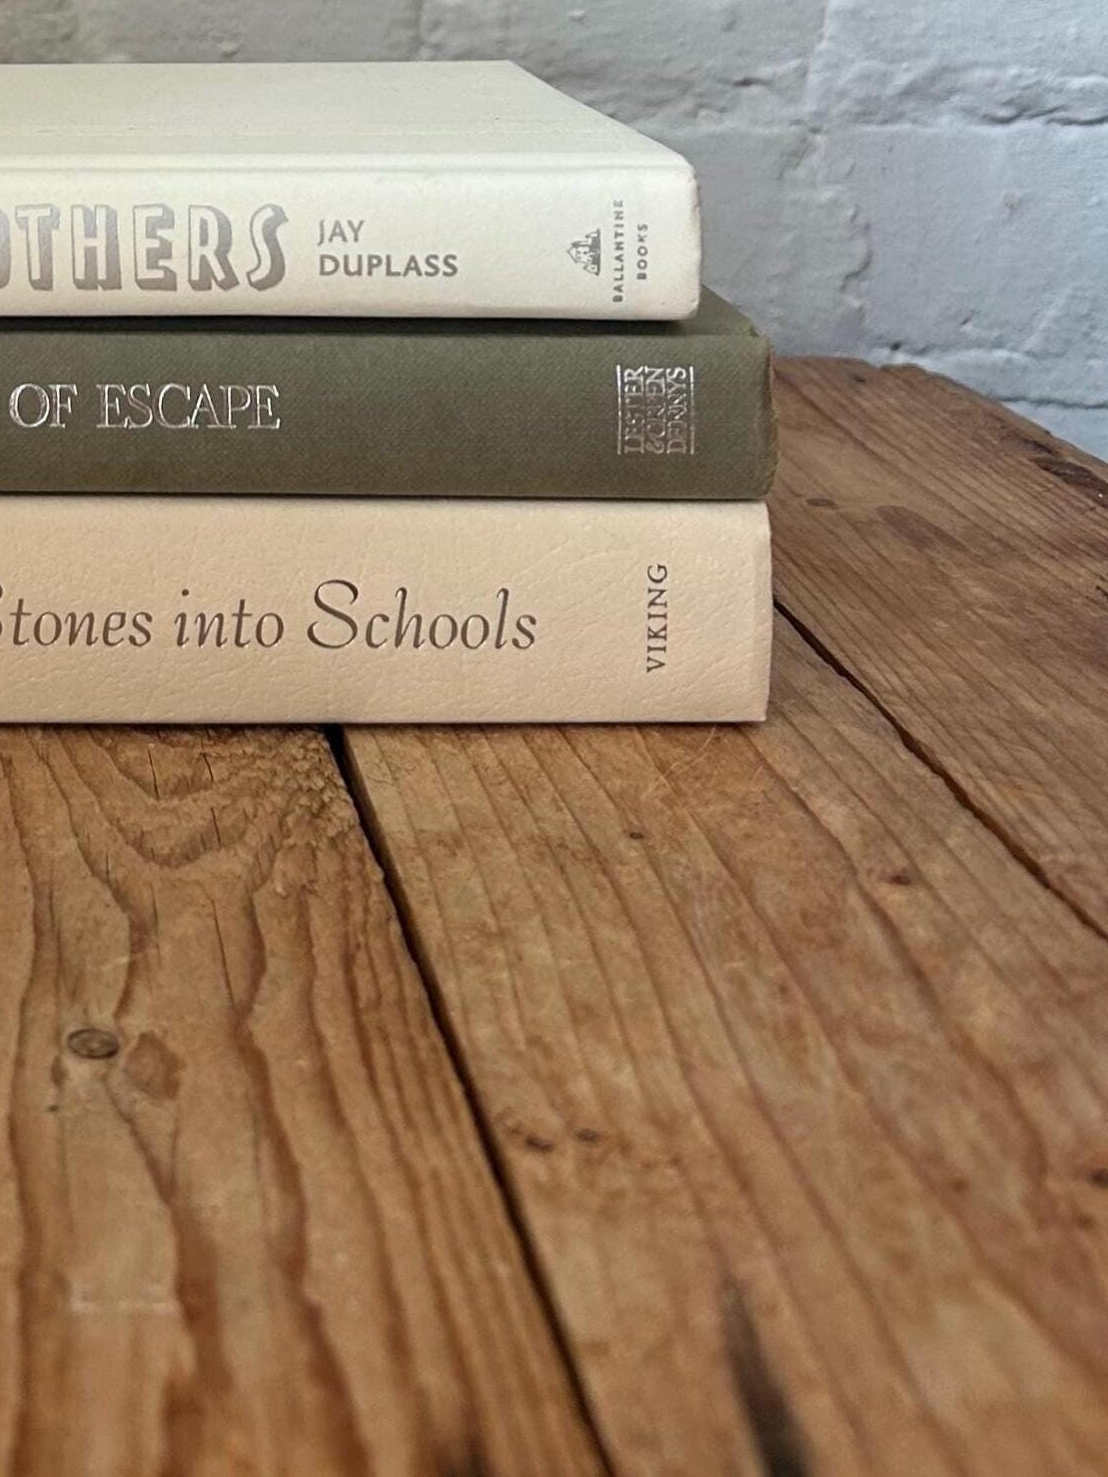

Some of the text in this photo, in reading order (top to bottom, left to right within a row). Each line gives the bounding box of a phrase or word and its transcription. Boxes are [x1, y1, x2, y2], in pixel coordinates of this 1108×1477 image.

[317, 219, 365, 247] JAY
[612, 200, 624, 303] BALLANTINE
[636, 223, 648, 280] BOOKS
[318, 254, 458, 278] DUPLASS
[8, 383, 78, 429] OF
[95, 383, 281, 430] ESCAPE
[624, 365, 644, 454] LESTER
[174, 589, 286, 650] into
[306, 578, 538, 651] Schools
[646, 563, 668, 674] VIKING
